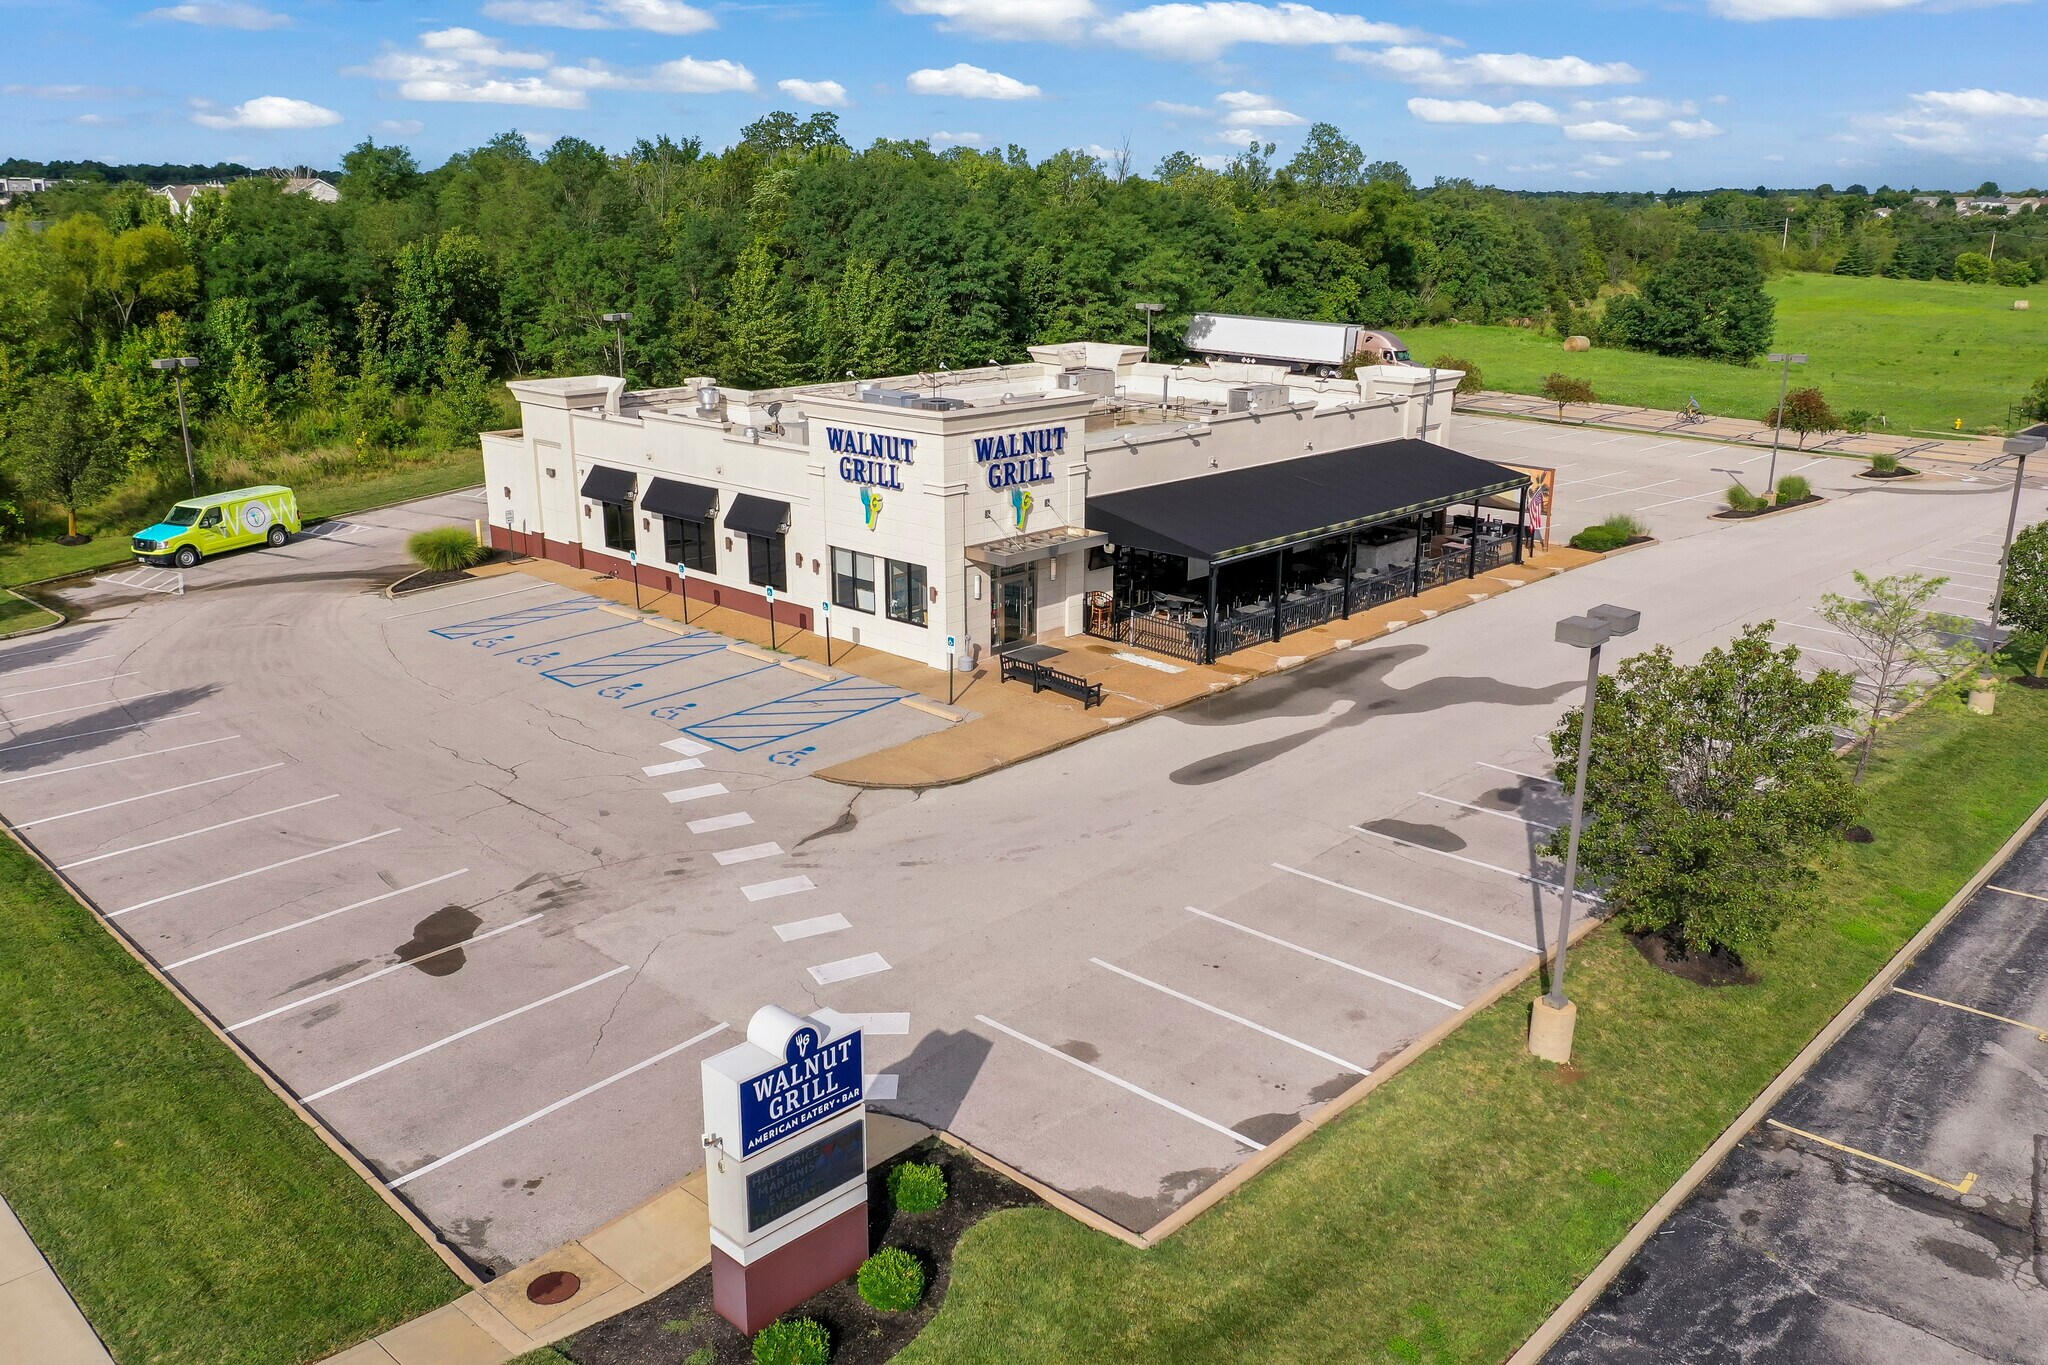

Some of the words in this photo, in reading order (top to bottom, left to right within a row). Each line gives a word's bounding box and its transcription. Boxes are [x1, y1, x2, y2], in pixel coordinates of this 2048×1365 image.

[826, 427, 915, 464] WALNUT
[974, 427, 1066, 463] WALNUT
[839, 456, 902, 491] GRILL
[988, 456, 1053, 489] GRILL
[752, 1038, 852, 1102] WALNUT
[769, 1071, 839, 1120] GRILL
[747, 1116, 799, 1150] AMERICAN
[800, 1098, 835, 1123] EATERY
[841, 1087, 860, 1103] BAR
[752, 1163, 783, 1189] HALF
[785, 1144, 821, 1170] PRICE
[757, 1163, 816, 1199] MARTINIS
[768, 1178, 806, 1206] EVERY
